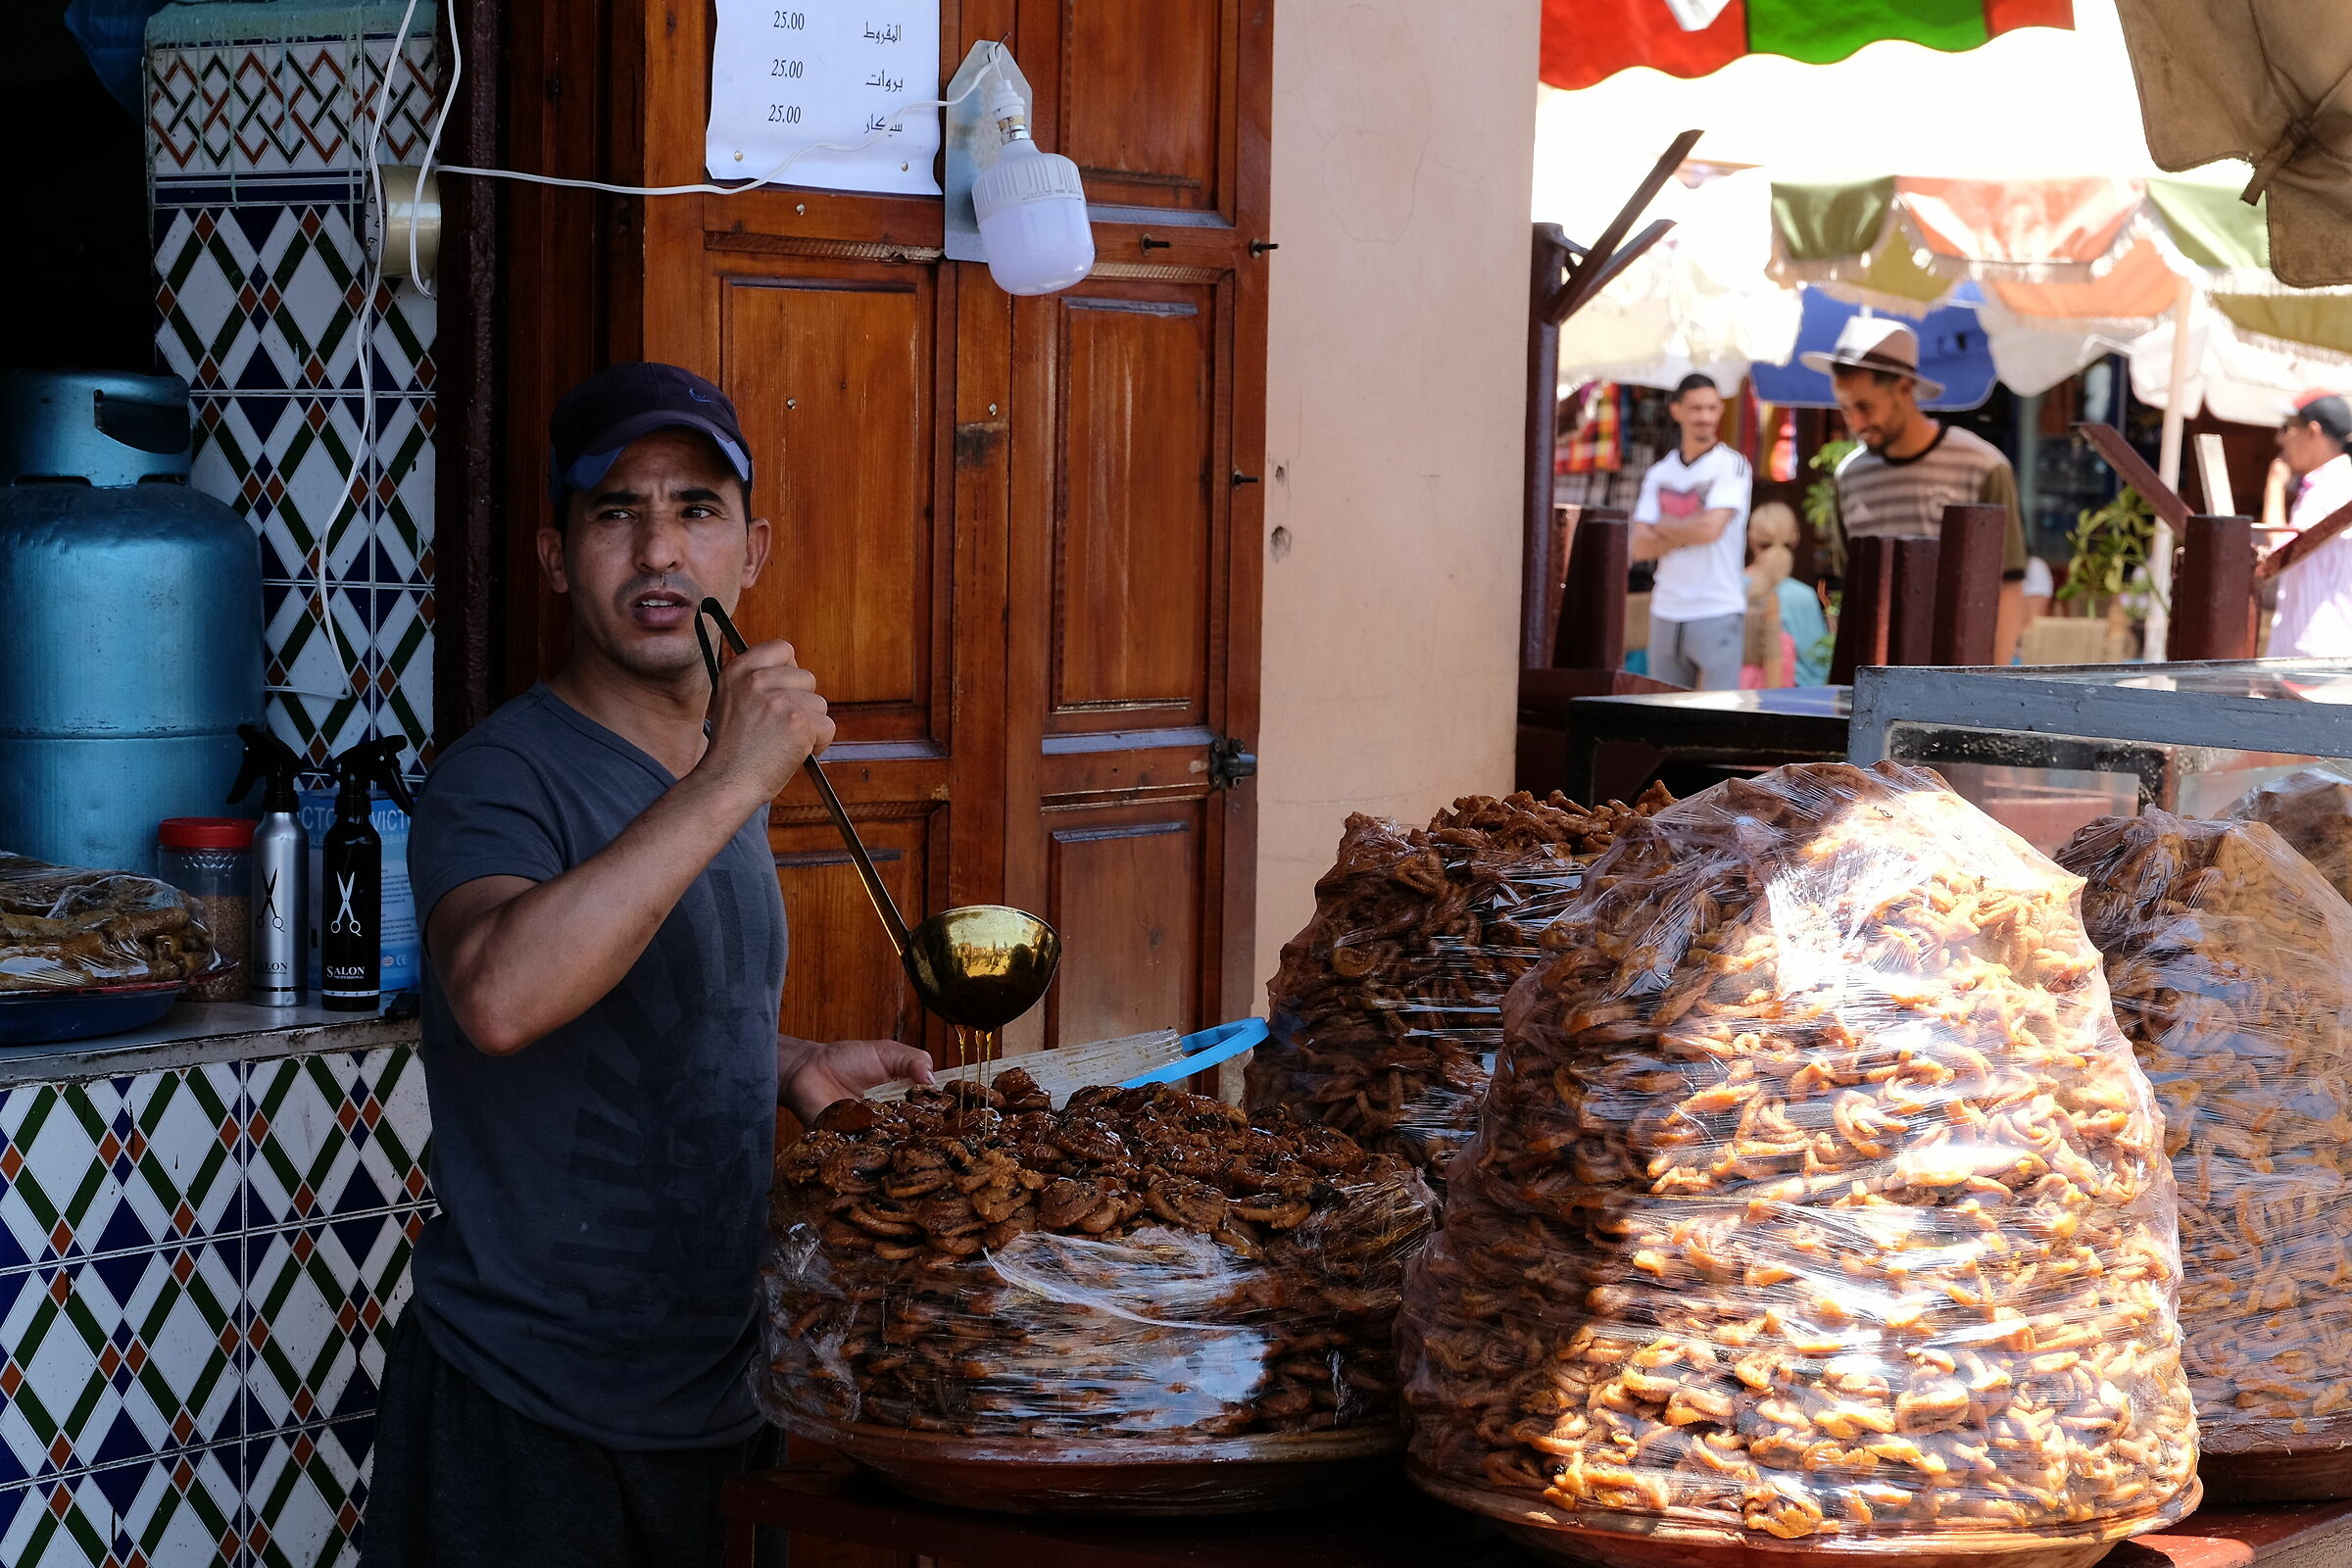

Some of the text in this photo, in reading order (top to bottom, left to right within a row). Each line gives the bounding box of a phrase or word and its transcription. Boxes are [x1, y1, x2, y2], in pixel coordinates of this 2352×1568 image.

[773, 10, 805, 30] 25.00
[770, 59, 804, 78] 25.00
[865, 69, 904, 93] بروات
[768, 104, 802, 124] 25.00
[326, 965, 365, 977] SALON
